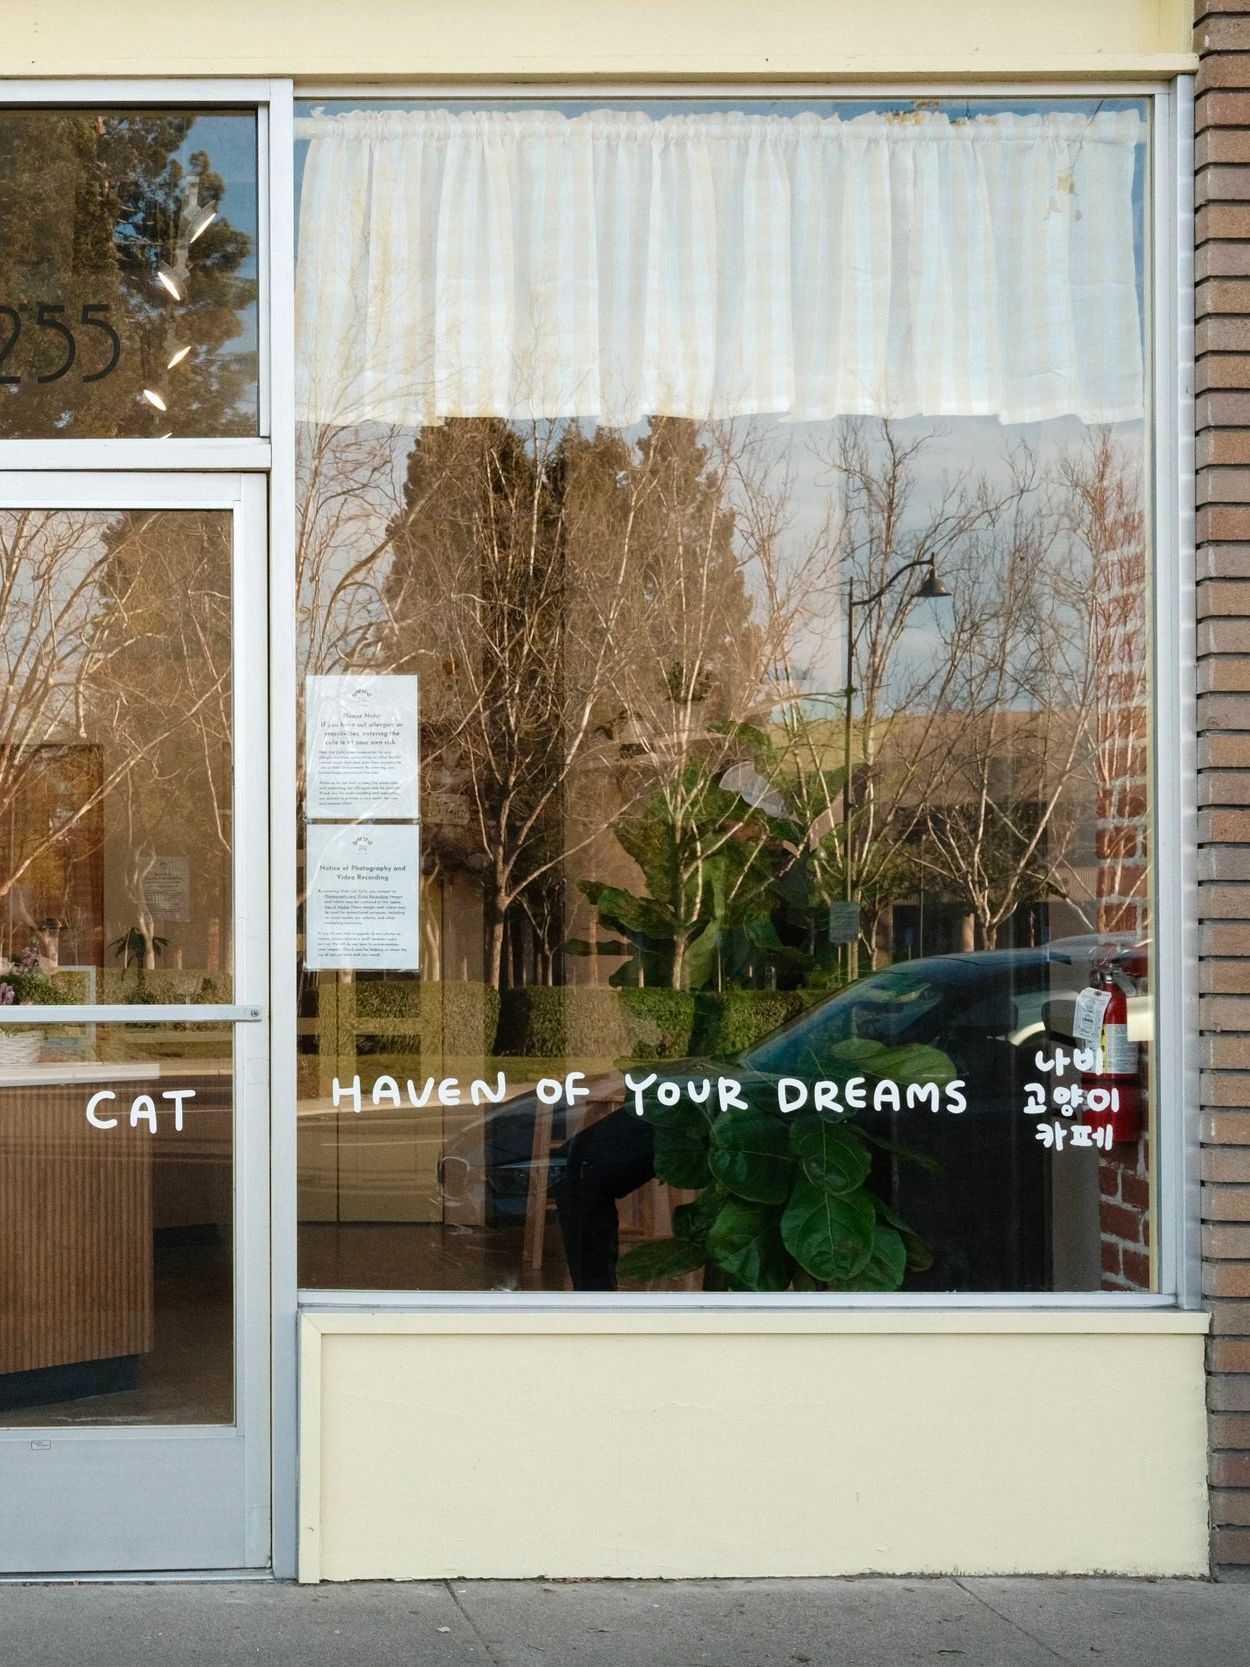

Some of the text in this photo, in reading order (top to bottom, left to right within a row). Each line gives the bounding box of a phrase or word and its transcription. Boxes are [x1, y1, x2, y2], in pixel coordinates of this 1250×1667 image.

[351, 865, 391, 873] Photography
[356, 874, 389, 882] Recording
[1035, 1048, 1103, 1076] 나비
[86, 1071, 967, 1134] CAT HAVEN OF YOUR DREAMS
[1023, 1082, 1120, 1117] 고양이
[1035, 1121, 1113, 1151] 카페
